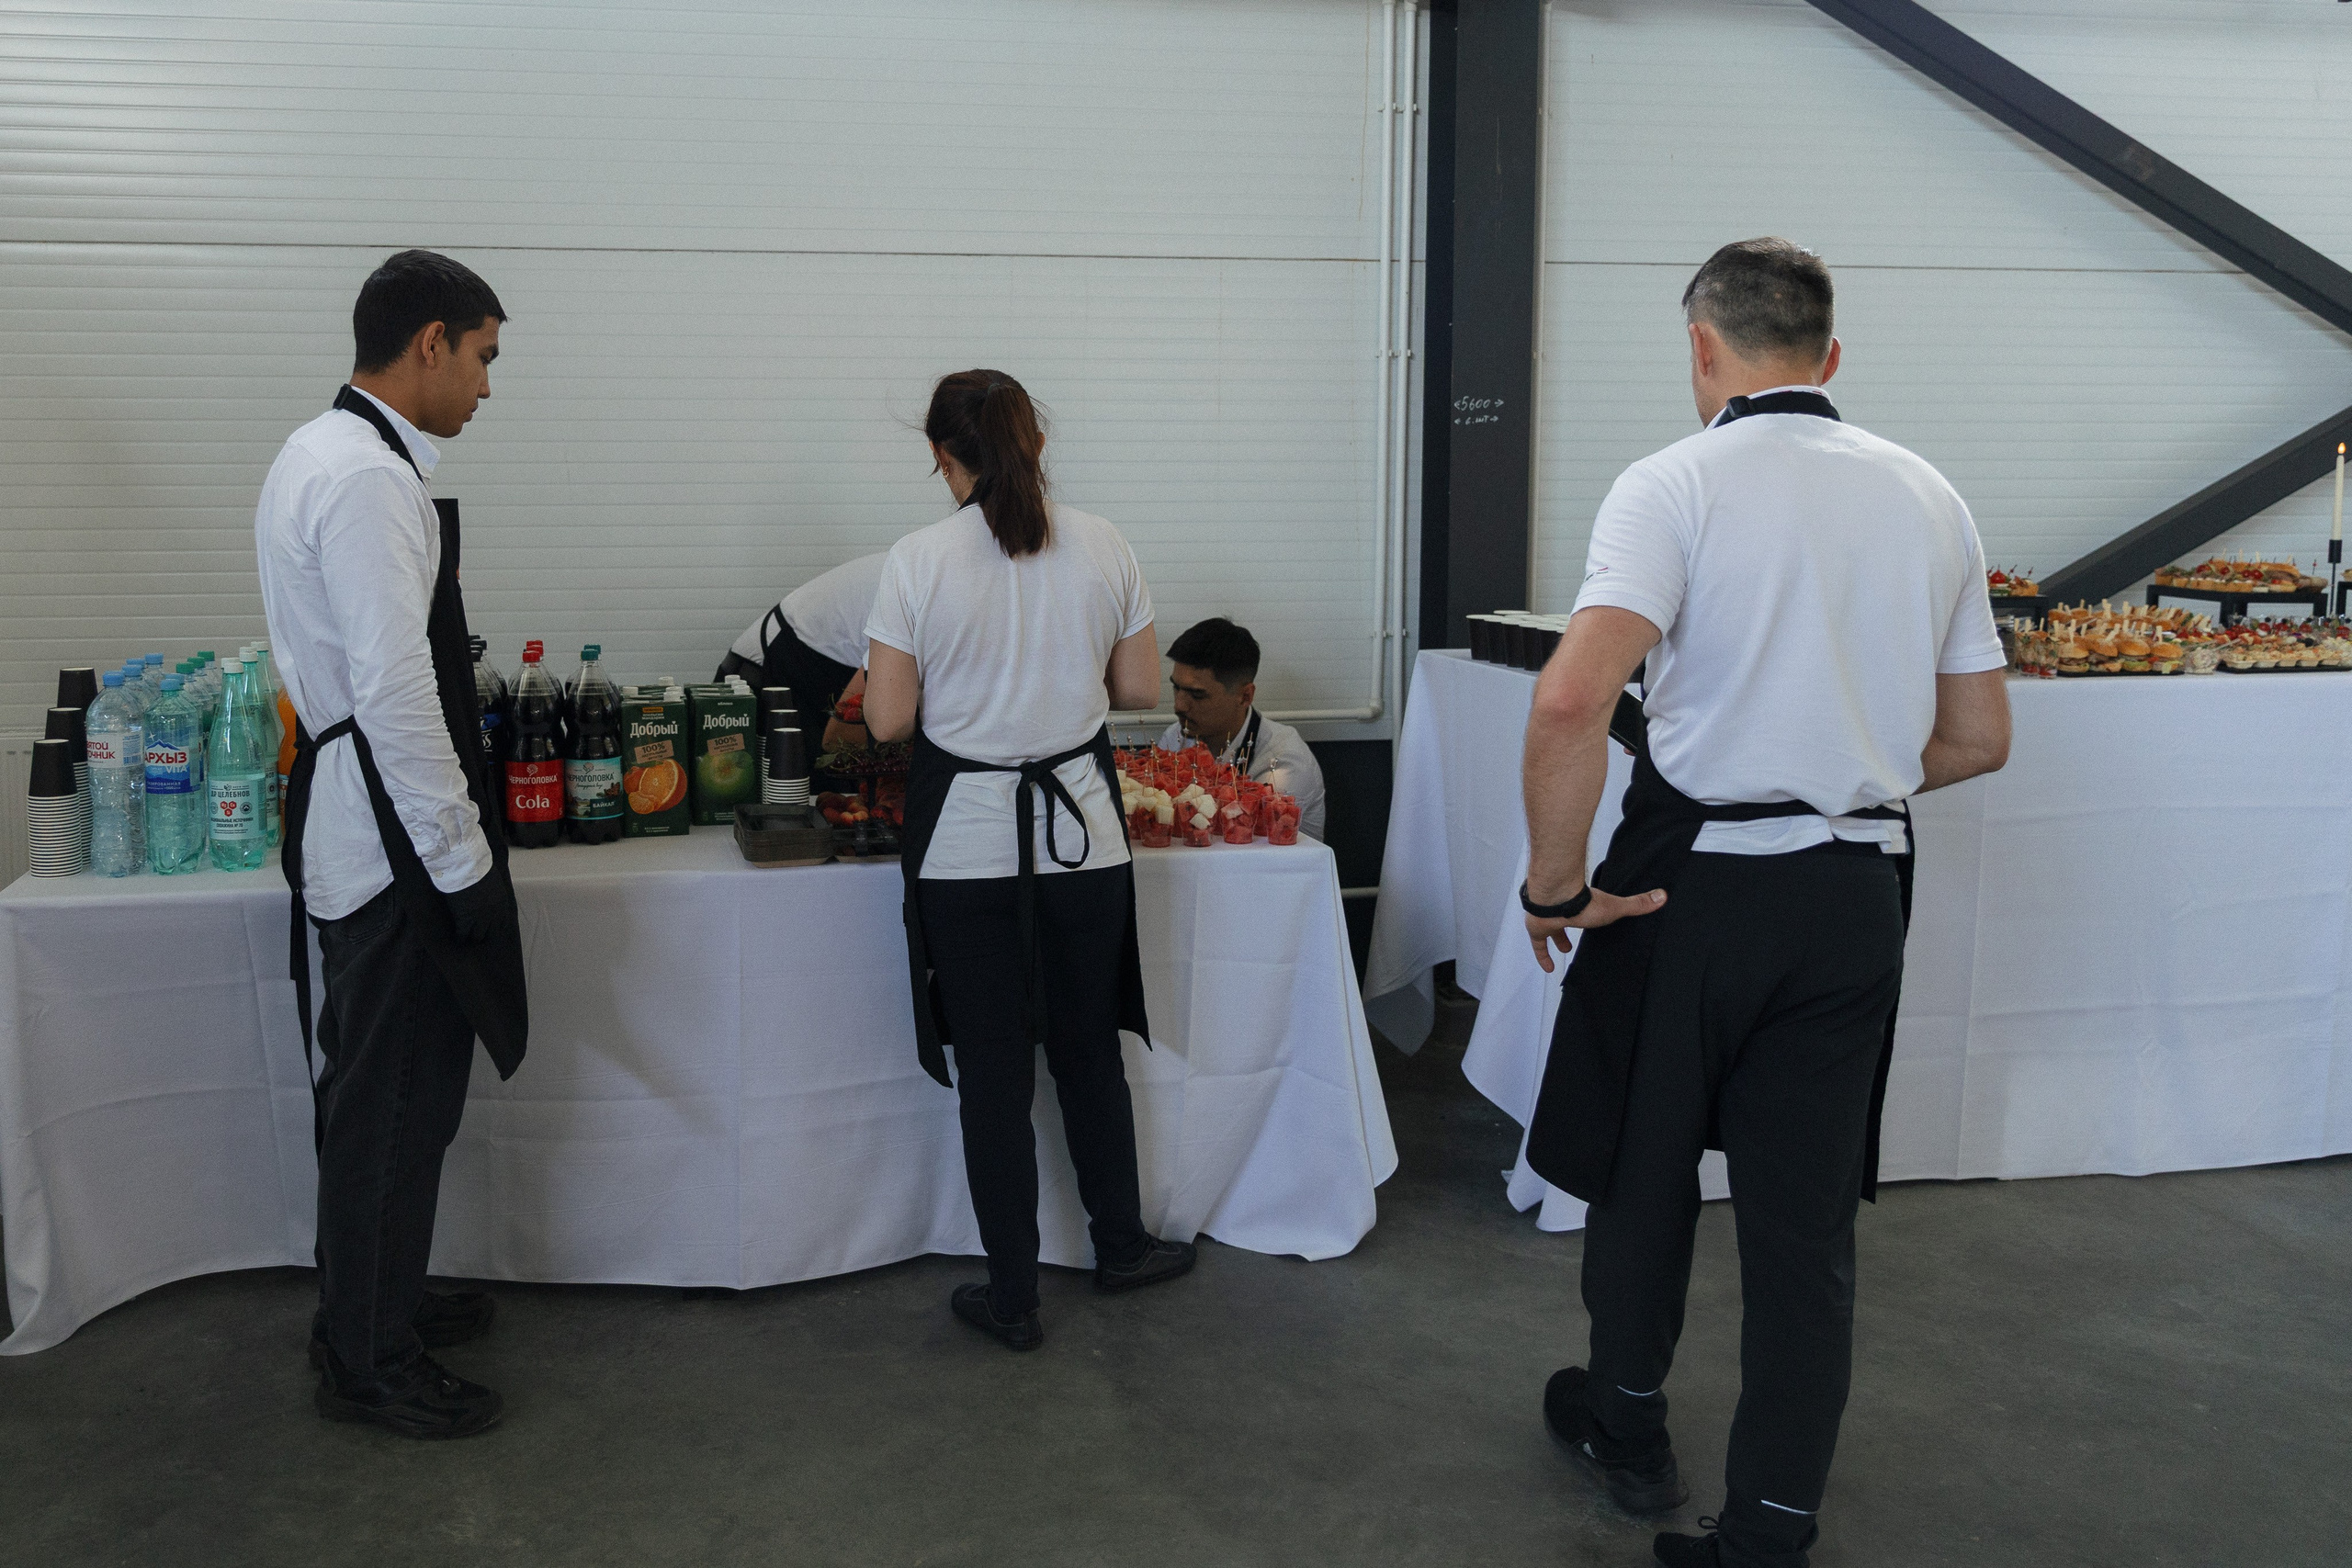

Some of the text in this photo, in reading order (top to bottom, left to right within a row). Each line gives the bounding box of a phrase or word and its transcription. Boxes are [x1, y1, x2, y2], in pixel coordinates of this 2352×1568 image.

[1461, 395, 1491, 412] 5600
[703, 713, 750, 729] Добрый
[629, 720, 679, 739] Добрый
[641, 741, 666, 754] 100%
[714, 735, 737, 747] 100%
[165, 765, 188, 773] VITA
[508, 774, 558, 784] ЧЕРНОГОЛОВКА
[218, 790, 250, 798] ЦЕЛЕБНОВ
[515, 795, 550, 809] Cola
